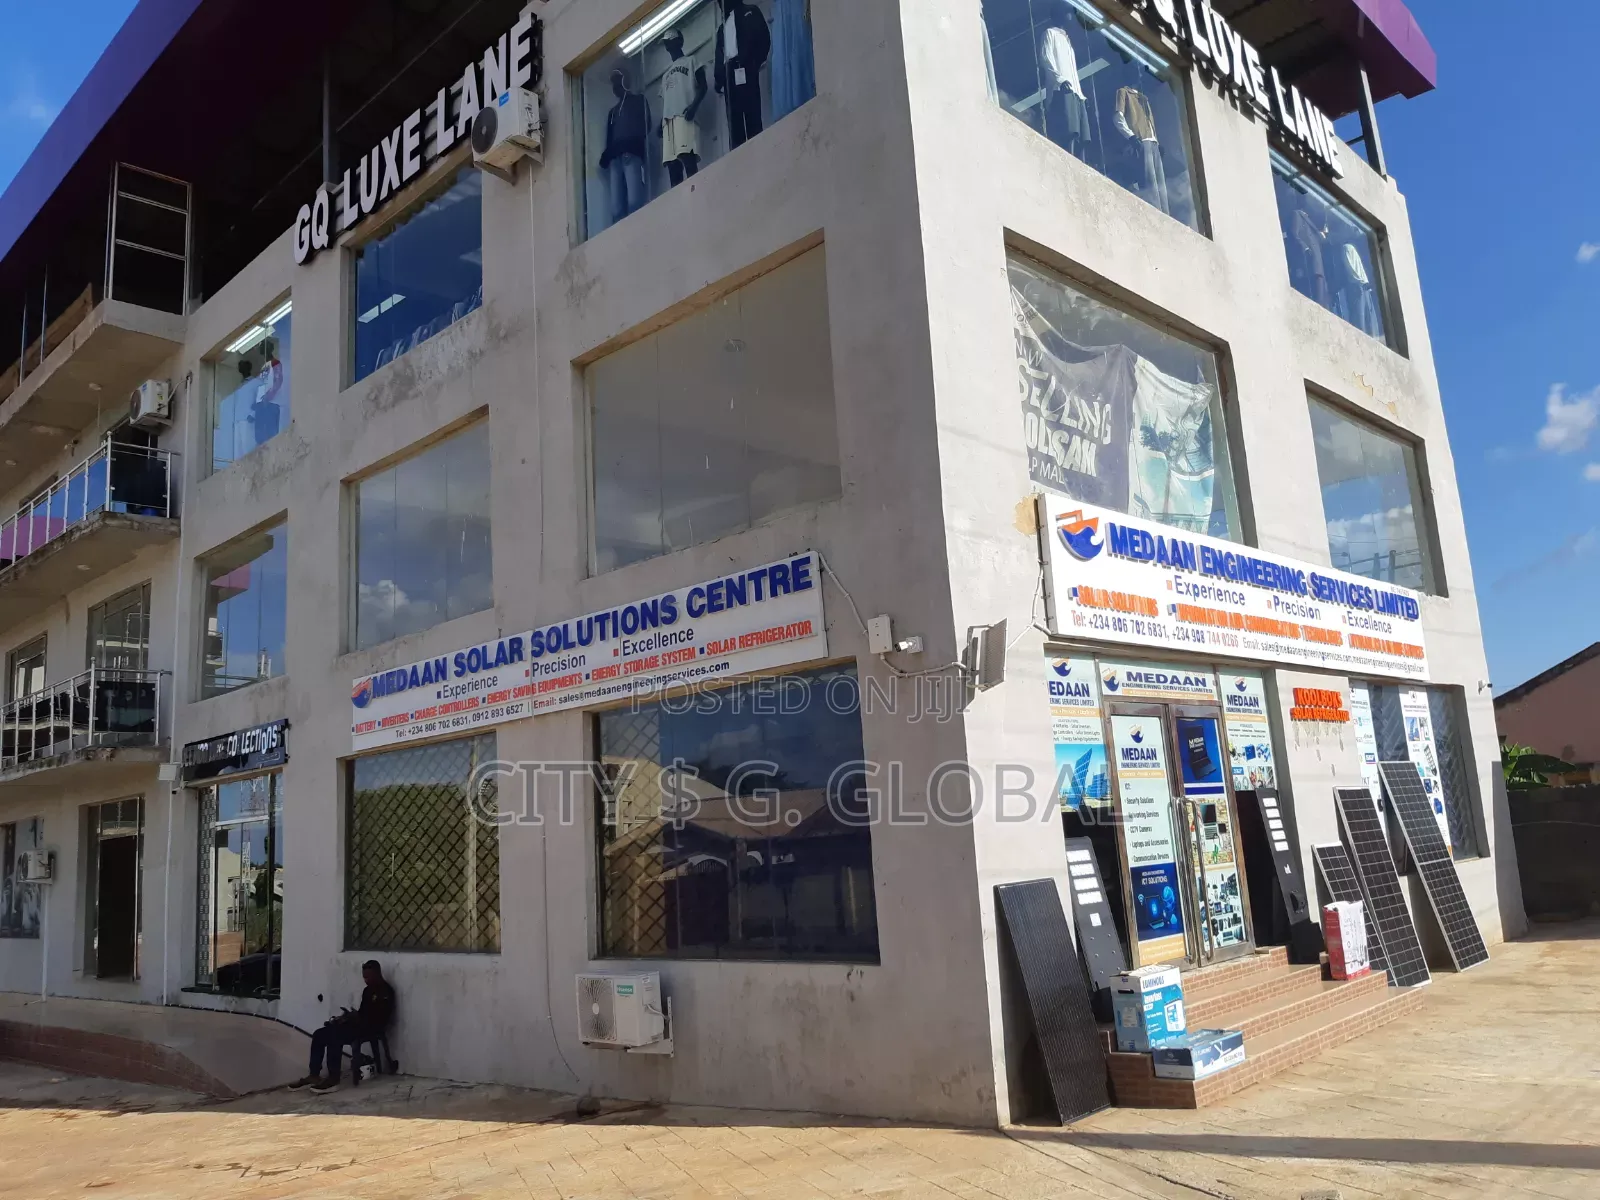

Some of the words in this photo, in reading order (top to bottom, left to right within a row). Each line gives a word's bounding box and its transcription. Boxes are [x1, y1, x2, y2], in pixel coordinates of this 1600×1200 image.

[1184, 0, 1271, 113] LUXE
[1271, 66, 1345, 180] LANE
[293, 189, 330, 265] GQ
[342, 107, 421, 230] LUXE
[436, 11, 534, 155] LANE
[1105, 522, 1197, 572] MEDAAN
[1197, 545, 1308, 597] ENGINEERING
[1307, 571, 1374, 611] SERVICES
[1373, 588, 1419, 620] LIMITED
[1077, 585, 1110, 609] SOLAR
[1110, 590, 1158, 617] SOLUTIONS
[1174, 575, 1246, 606] Experience
[1273, 595, 1322, 621] Precision
[1347, 611, 1392, 634] Excellence
[371, 656, 448, 700] MEDAAN
[453, 636, 524, 678] SOLAR
[530, 594, 679, 659] SOLUTIONS
[686, 555, 813, 619] CENTRE
[1071, 610, 1087, 628] Tel:
[1089, 614, 1111, 631] +234
[1112, 617, 1128, 633] 806
[1130, 619, 1146, 634] 702
[1148, 622, 1170, 642] 6831,
[1172, 626, 1190, 642] +234
[356, 719, 376, 734] BATTERY
[382, 712, 410, 729] INVERTERS
[414, 705, 438, 721] CHARGE
[438, 696, 480, 717] CONTROLLERS
[487, 688, 511, 705] ENERGY
[513, 682, 537, 699] SAVING
[538, 672, 583, 694] EQUIPMENTS
[592, 663, 622, 681] ENERGY
[624, 654, 660, 676] STORAGE
[661, 646, 697, 667] SYSTEM
[706, 637, 737, 656] SOLAR
[738, 619, 813, 649] REFRIGERATOR
[443, 675, 499, 700] Experience
[532, 654, 586, 678] Precision
[623, 628, 695, 657] Excellence
[1126, 671, 1207, 688] MEDAAN
[1121, 682, 1162, 690] ENGINEERING
[1225, 694, 1260, 709] MEDAAN
[1293, 688, 1343, 709] KOOLBOKS
[396, 727, 408, 739] Tel:
[408, 723, 424, 736] +234
[424, 721, 437, 735] 806
[438, 719, 451, 732] 702
[452, 715, 471, 730] 6831,
[472, 710, 489, 723] 0912
[491, 706, 505, 719] 893
[506, 703, 524, 717] 6527
[533, 695, 557, 710] Email:
[1121, 747, 1158, 761] MEDAAN
[1148, 875, 1168, 885] SOLUTIONS
